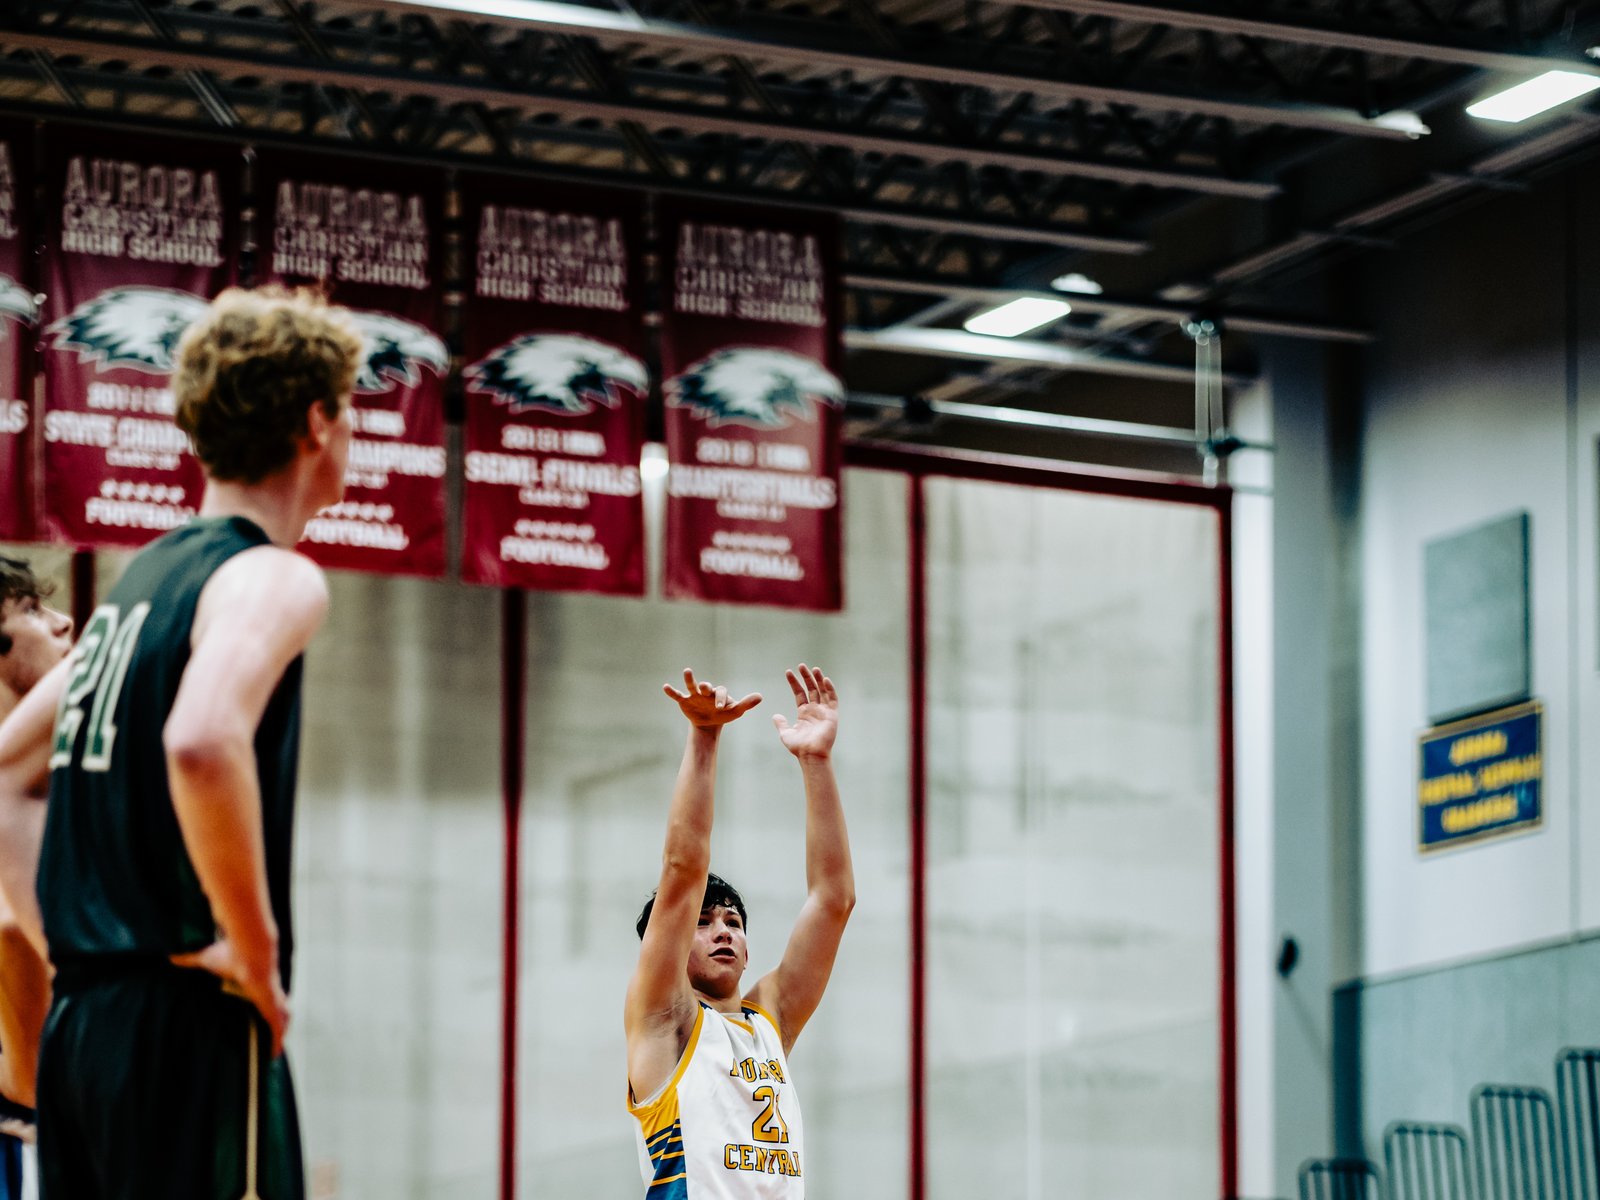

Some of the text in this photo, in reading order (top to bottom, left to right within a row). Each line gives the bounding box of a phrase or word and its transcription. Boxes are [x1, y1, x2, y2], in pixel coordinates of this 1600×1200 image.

[65, 157, 221, 213] AURORA
[276, 179, 425, 236] AURORA
[50, 602, 151, 774] 21
